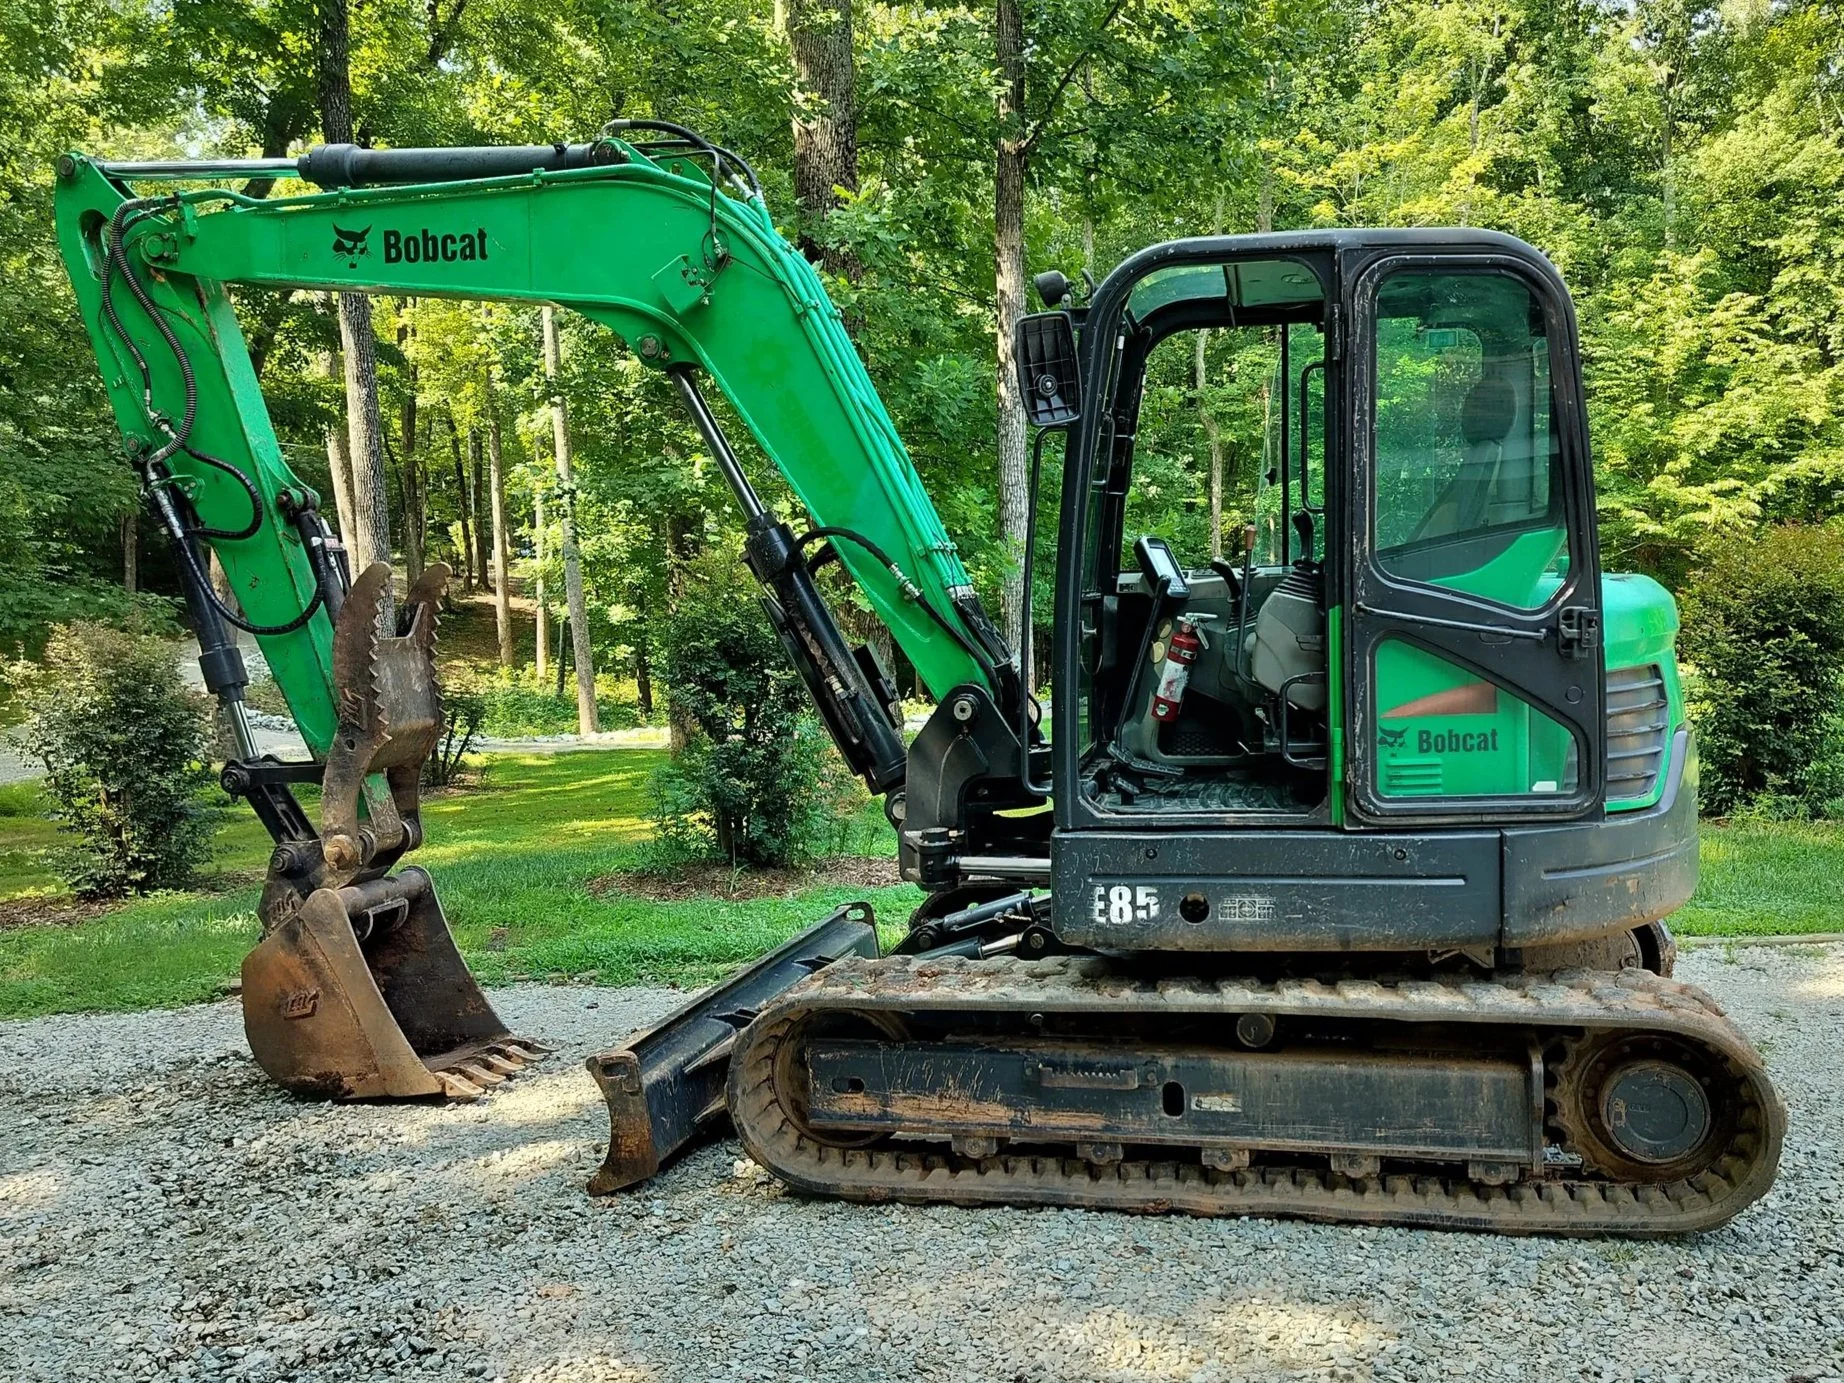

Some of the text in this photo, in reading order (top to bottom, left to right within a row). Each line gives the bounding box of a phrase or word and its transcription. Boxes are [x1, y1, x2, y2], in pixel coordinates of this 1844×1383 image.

[384, 228, 488, 263] Bobcat
[1418, 729, 1498, 753] Bobcat
[1090, 885, 1161, 925] E85
